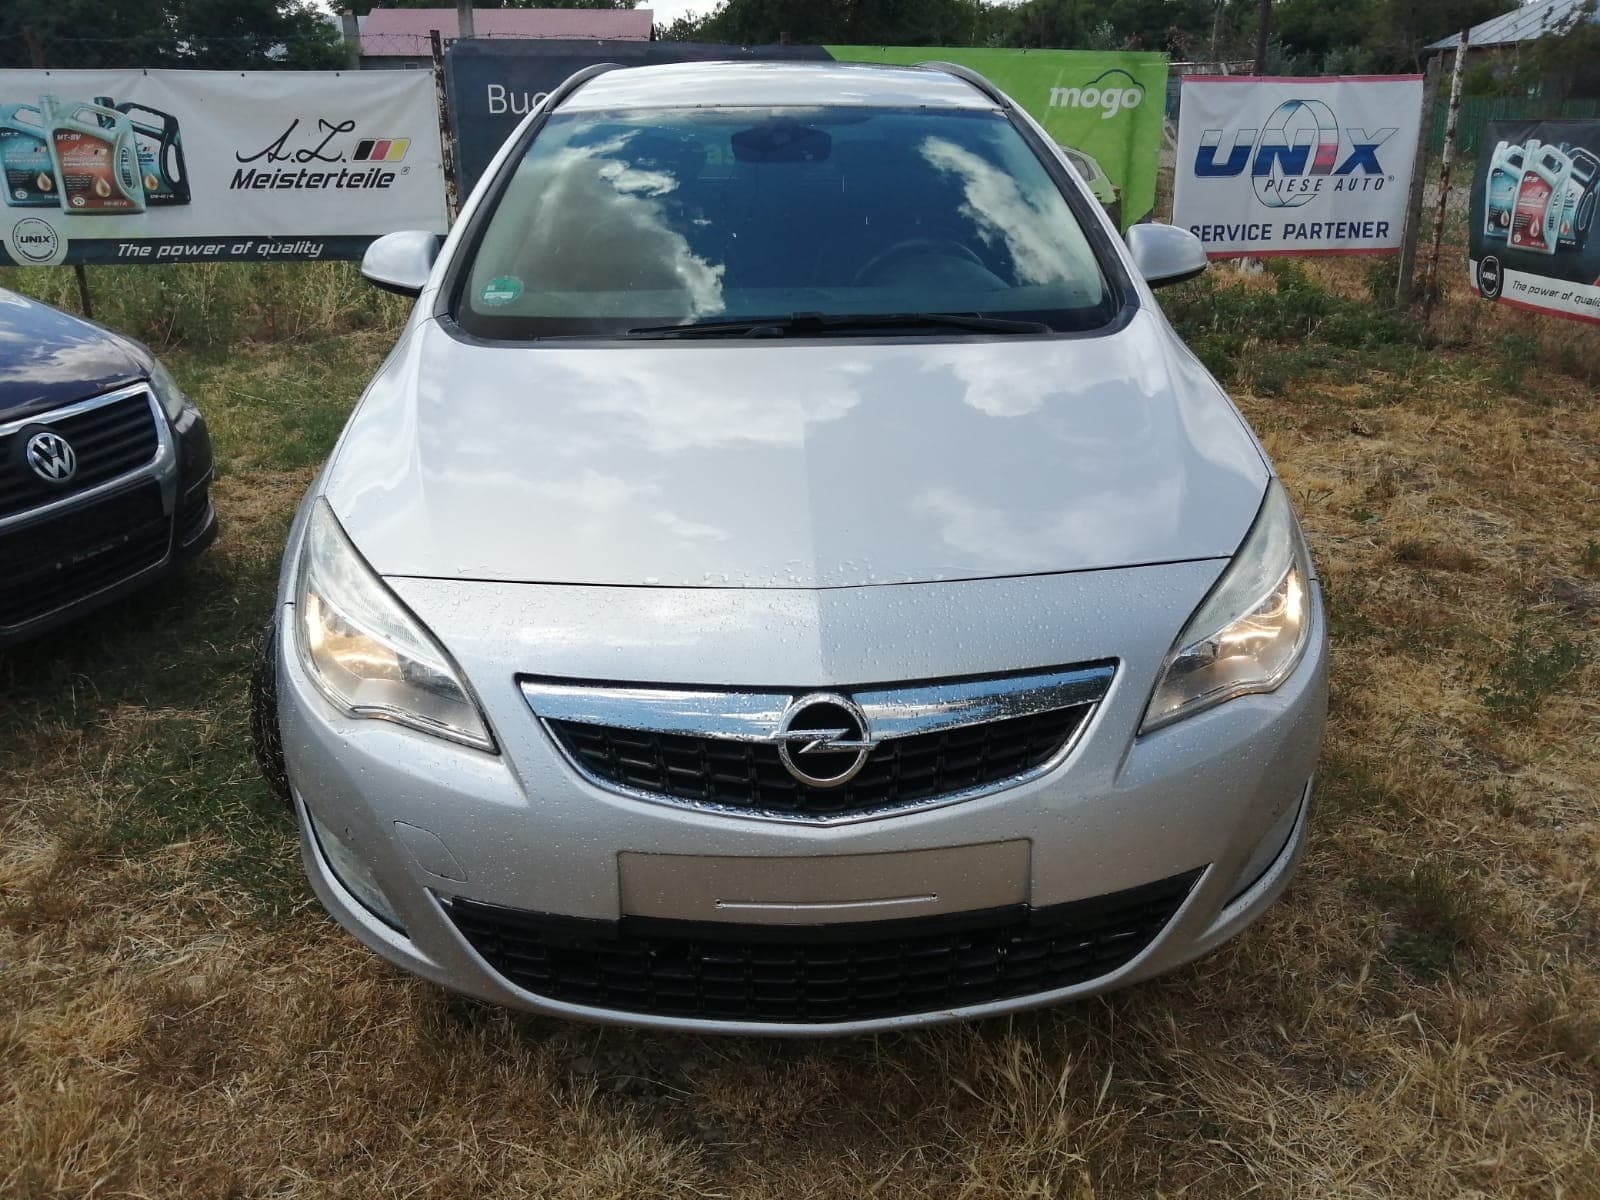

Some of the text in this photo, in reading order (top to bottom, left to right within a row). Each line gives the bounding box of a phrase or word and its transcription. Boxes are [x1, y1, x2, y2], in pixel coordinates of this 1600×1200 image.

[1049, 88, 1142, 119] mogo
[1194, 128, 1400, 178] UNIX
[230, 168, 395, 189] Meisterteile
[1264, 177, 1385, 193] PIESE AUTO
[20, 235, 51, 243] UNIX
[1190, 221, 1389, 241] SERVICE PARTENER
[117, 240, 324, 259] The power of quality
[1512, 280, 1527, 291] The
[1528, 285, 1560, 298] power
[1561, 291, 1573, 301] of
